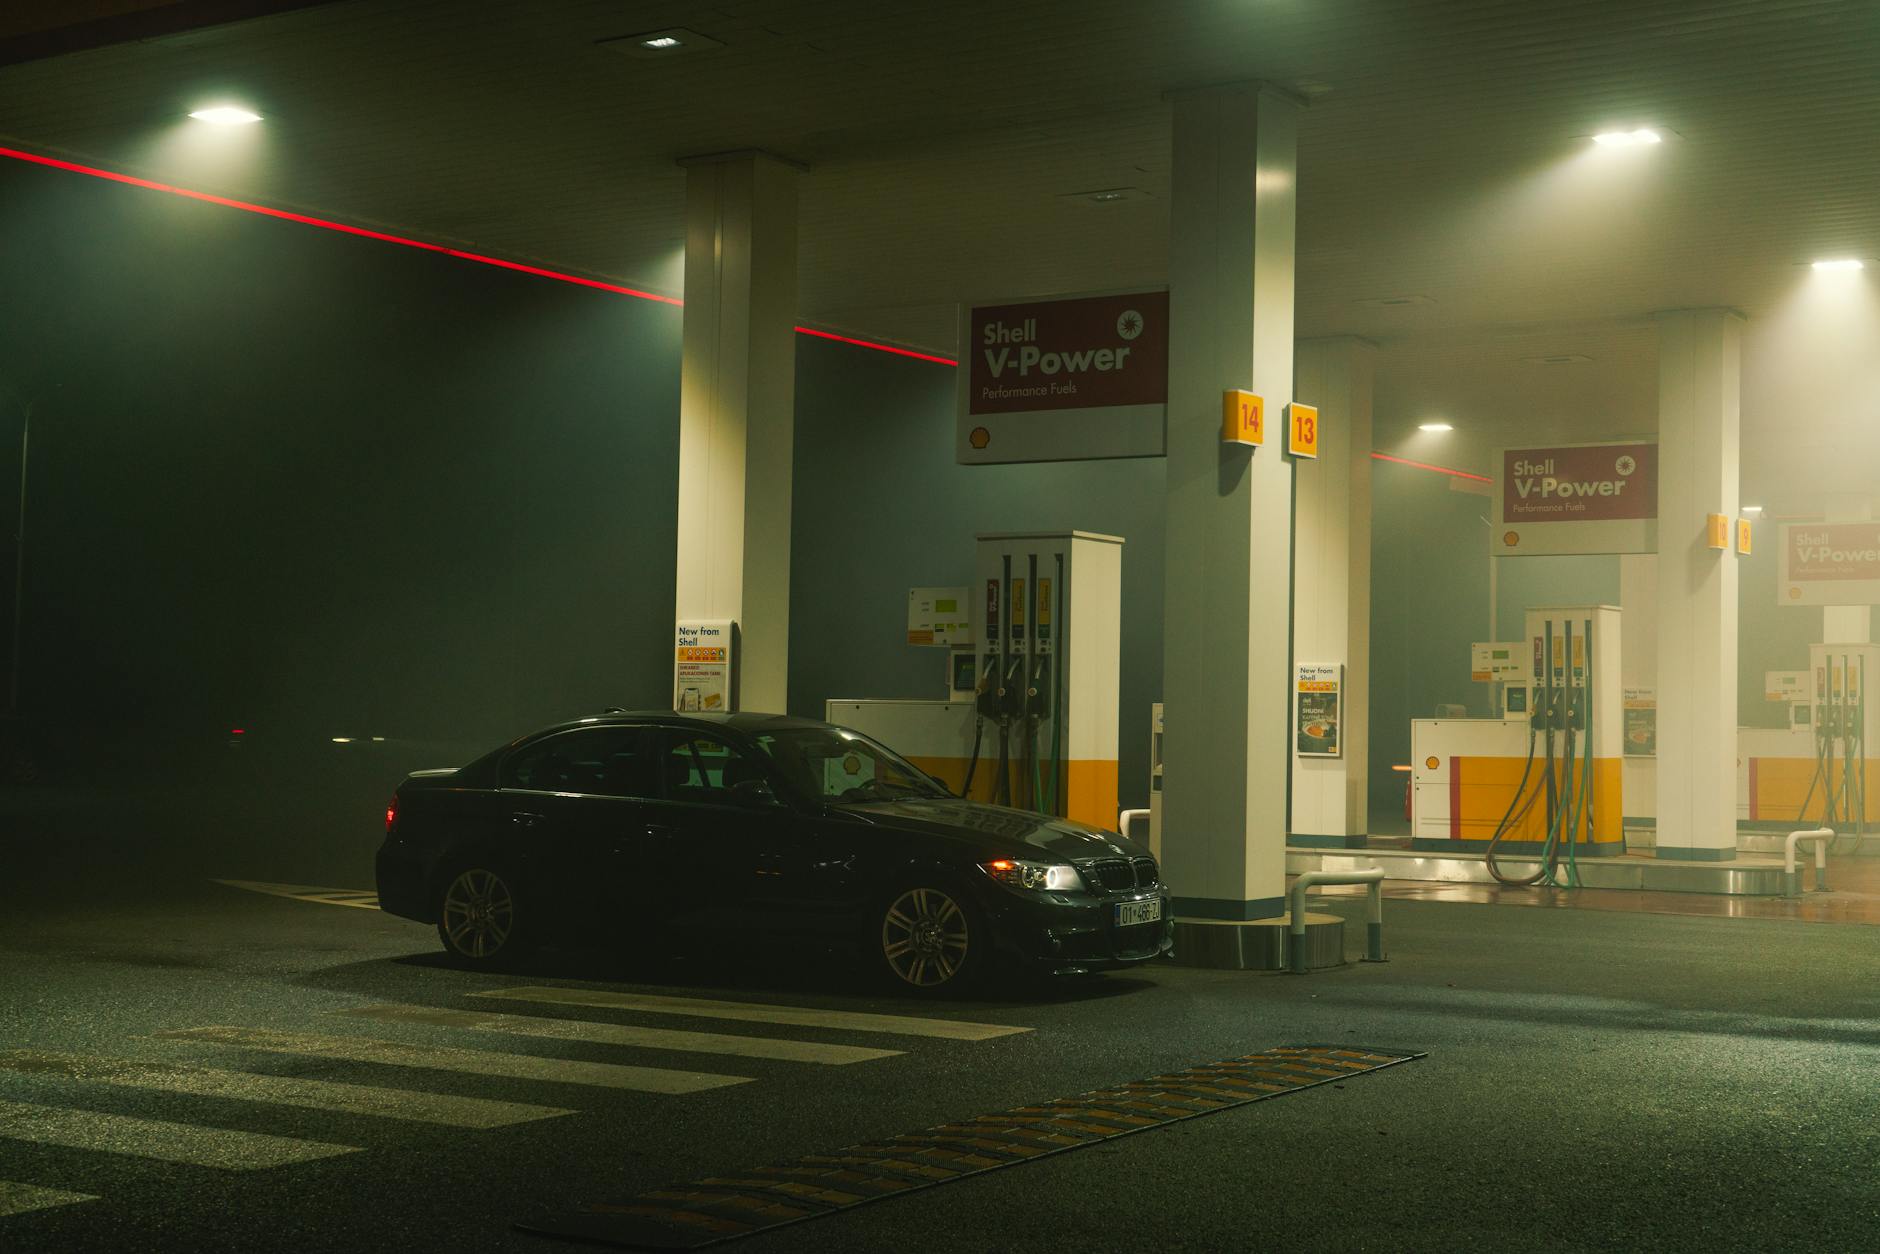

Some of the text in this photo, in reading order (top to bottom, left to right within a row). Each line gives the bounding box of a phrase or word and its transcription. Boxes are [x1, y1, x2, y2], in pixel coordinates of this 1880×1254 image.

[984, 318, 1036, 345] Shell
[984, 346, 1130, 378] V-Power
[983, 381, 1077, 399] Performance Fuels
[1242, 404, 1259, 432] 14
[1296, 417, 1314, 444] 13
[1513, 458, 1554, 476] Shell
[1514, 477, 1626, 498] V-Power
[1513, 501, 1586, 513] Performance Fuels
[1795, 531, 1829, 545] Shell
[679, 626, 720, 636] New from
[679, 637, 698, 646] Shell
[1317, 666, 1333, 674] from
